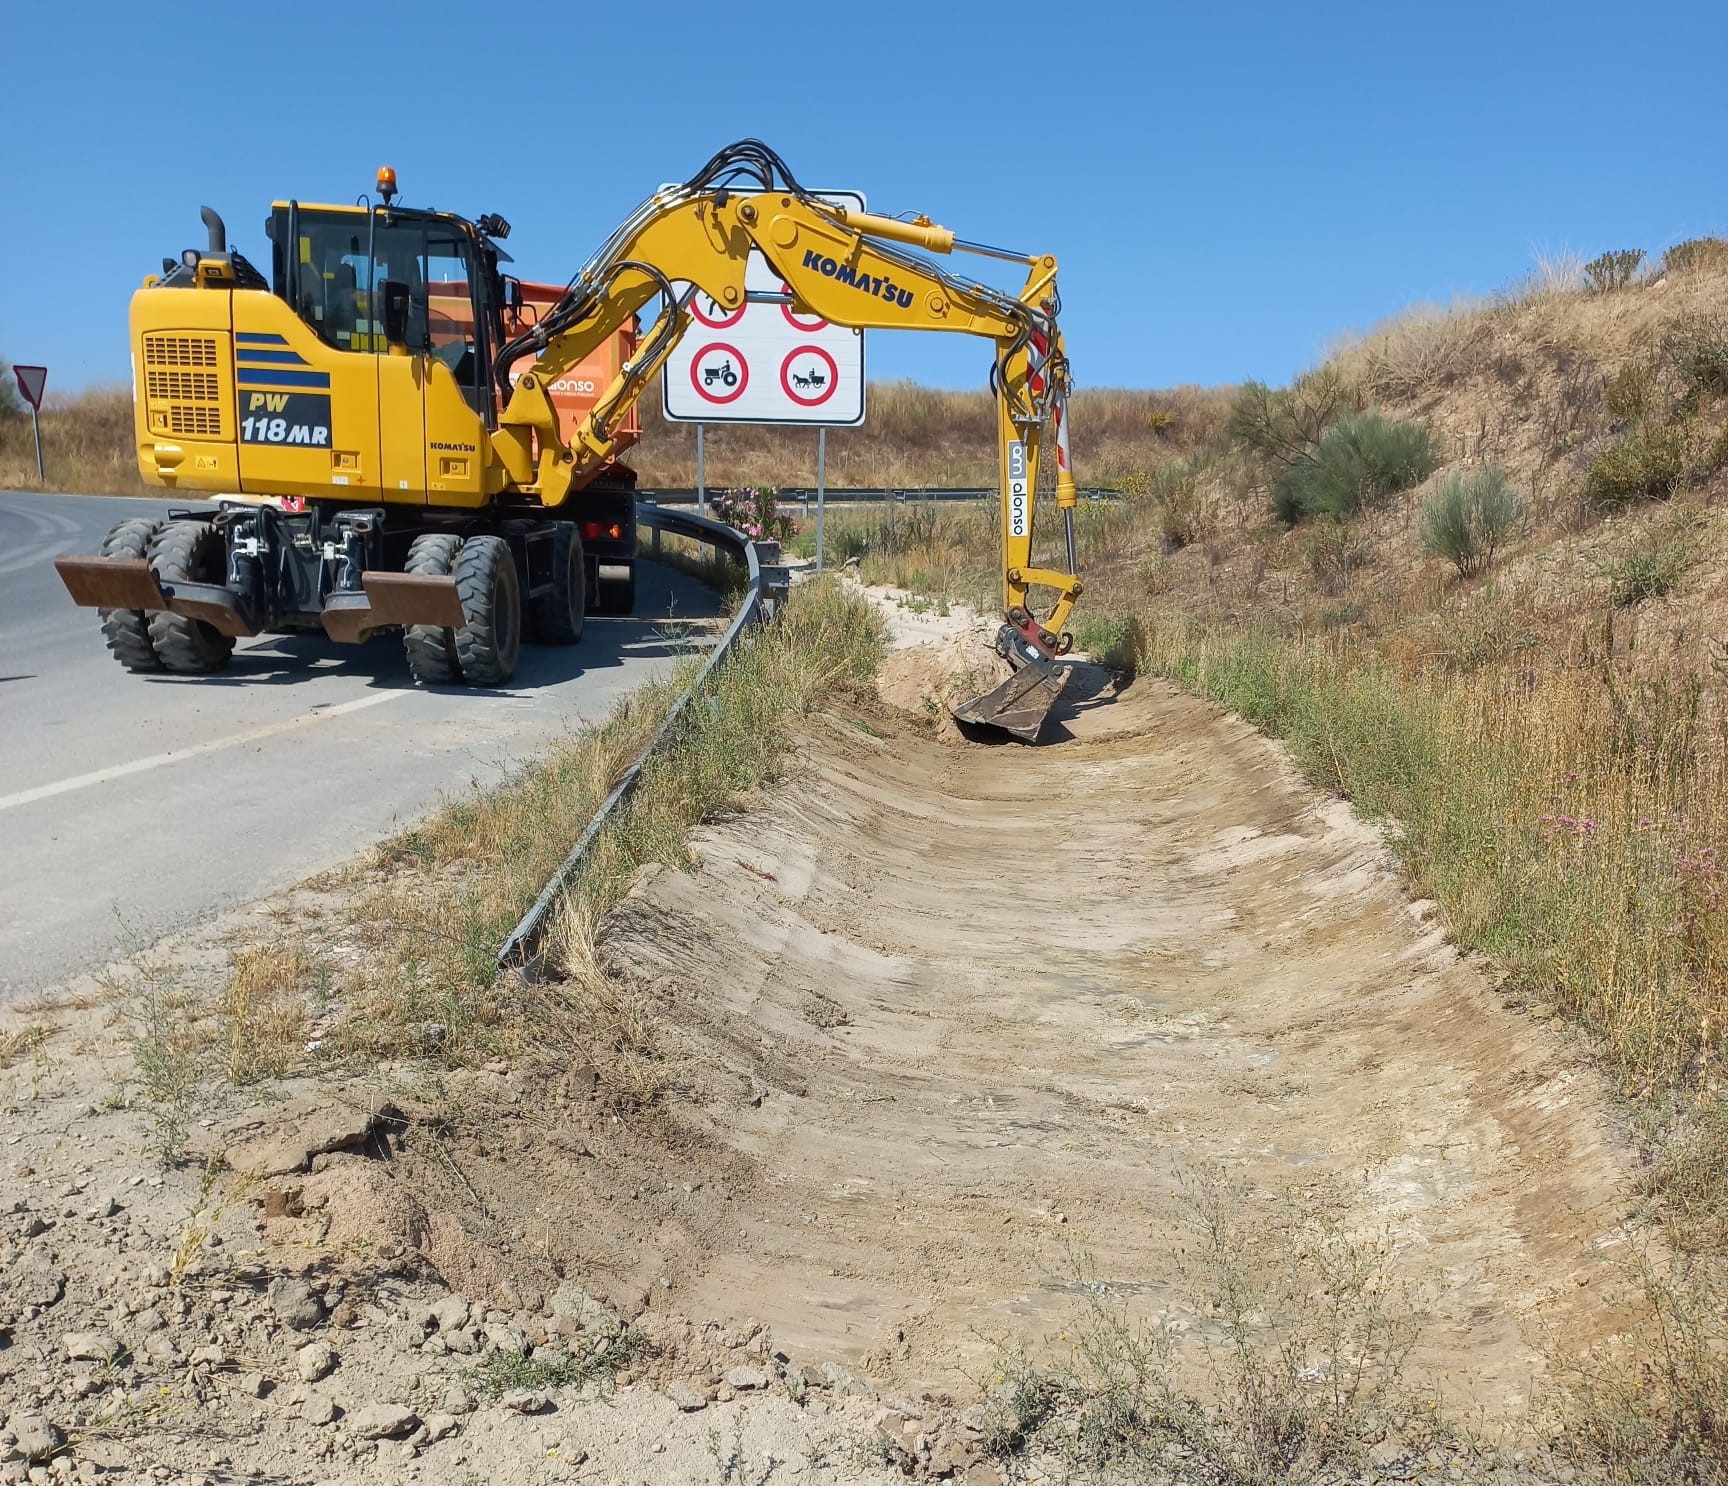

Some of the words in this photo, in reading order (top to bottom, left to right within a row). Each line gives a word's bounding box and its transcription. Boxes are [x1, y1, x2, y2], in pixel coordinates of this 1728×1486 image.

[802, 249, 914, 308] KOMATSU
[547, 379, 595, 393] lonso
[248, 393, 290, 413] PW
[430, 442, 476, 452] KOMATSU
[1012, 445, 1023, 475] am
[1013, 482, 1027, 535] alonso
